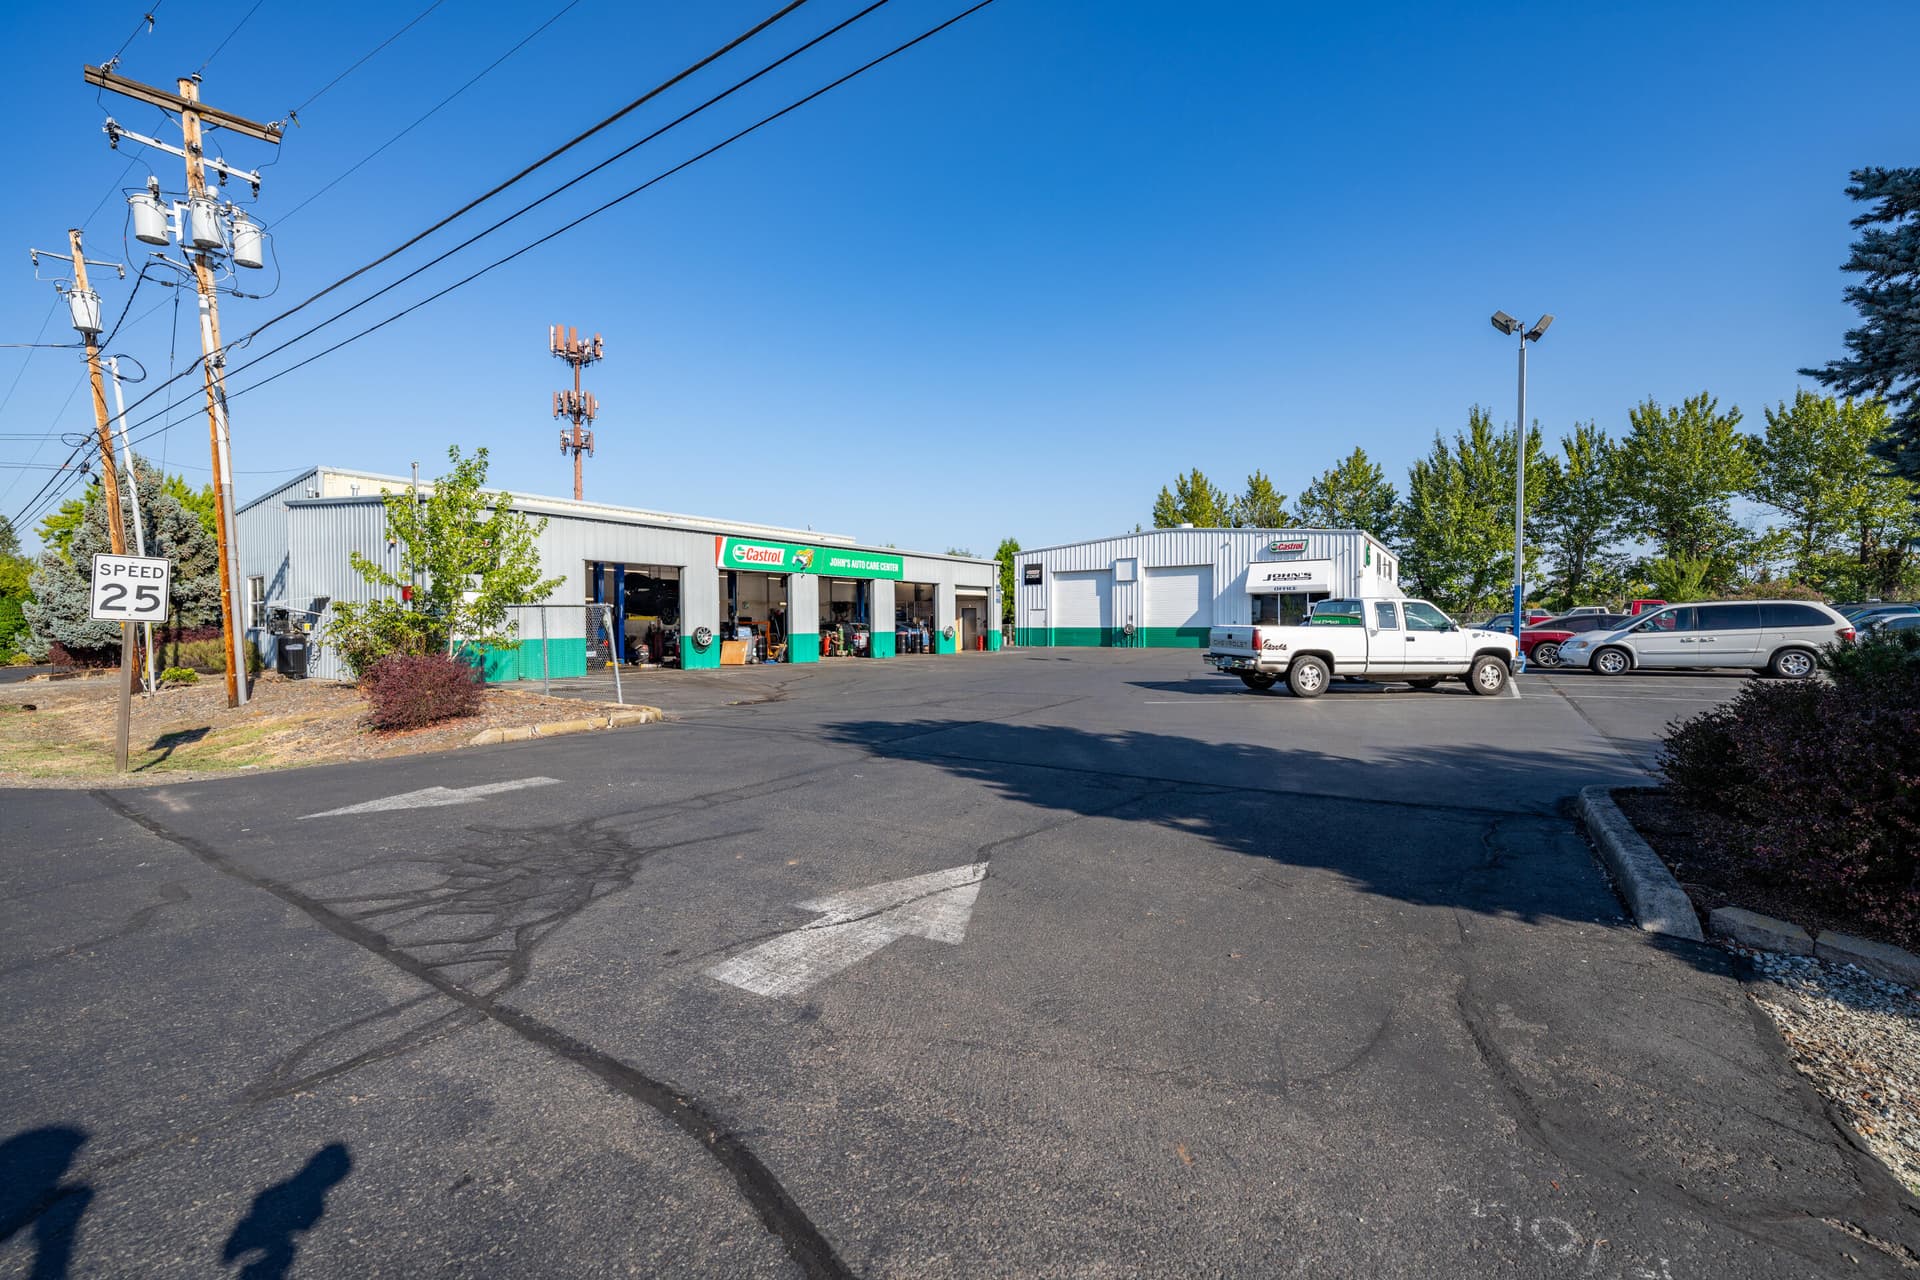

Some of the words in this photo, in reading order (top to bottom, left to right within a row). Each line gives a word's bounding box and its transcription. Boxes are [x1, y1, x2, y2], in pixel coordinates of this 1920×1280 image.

[746, 548, 781, 563] Castrol
[99, 563, 164, 579] SPEED
[829, 558, 850, 568] JOHN'S
[851, 560, 866, 569] AUTO
[866, 561, 880, 571] CARE
[880, 562, 899, 573] CENTER
[1263, 572, 1312, 581] JOHN'S
[99, 583, 160, 612] 25
[1213, 640, 1248, 648] CHEVROLET
